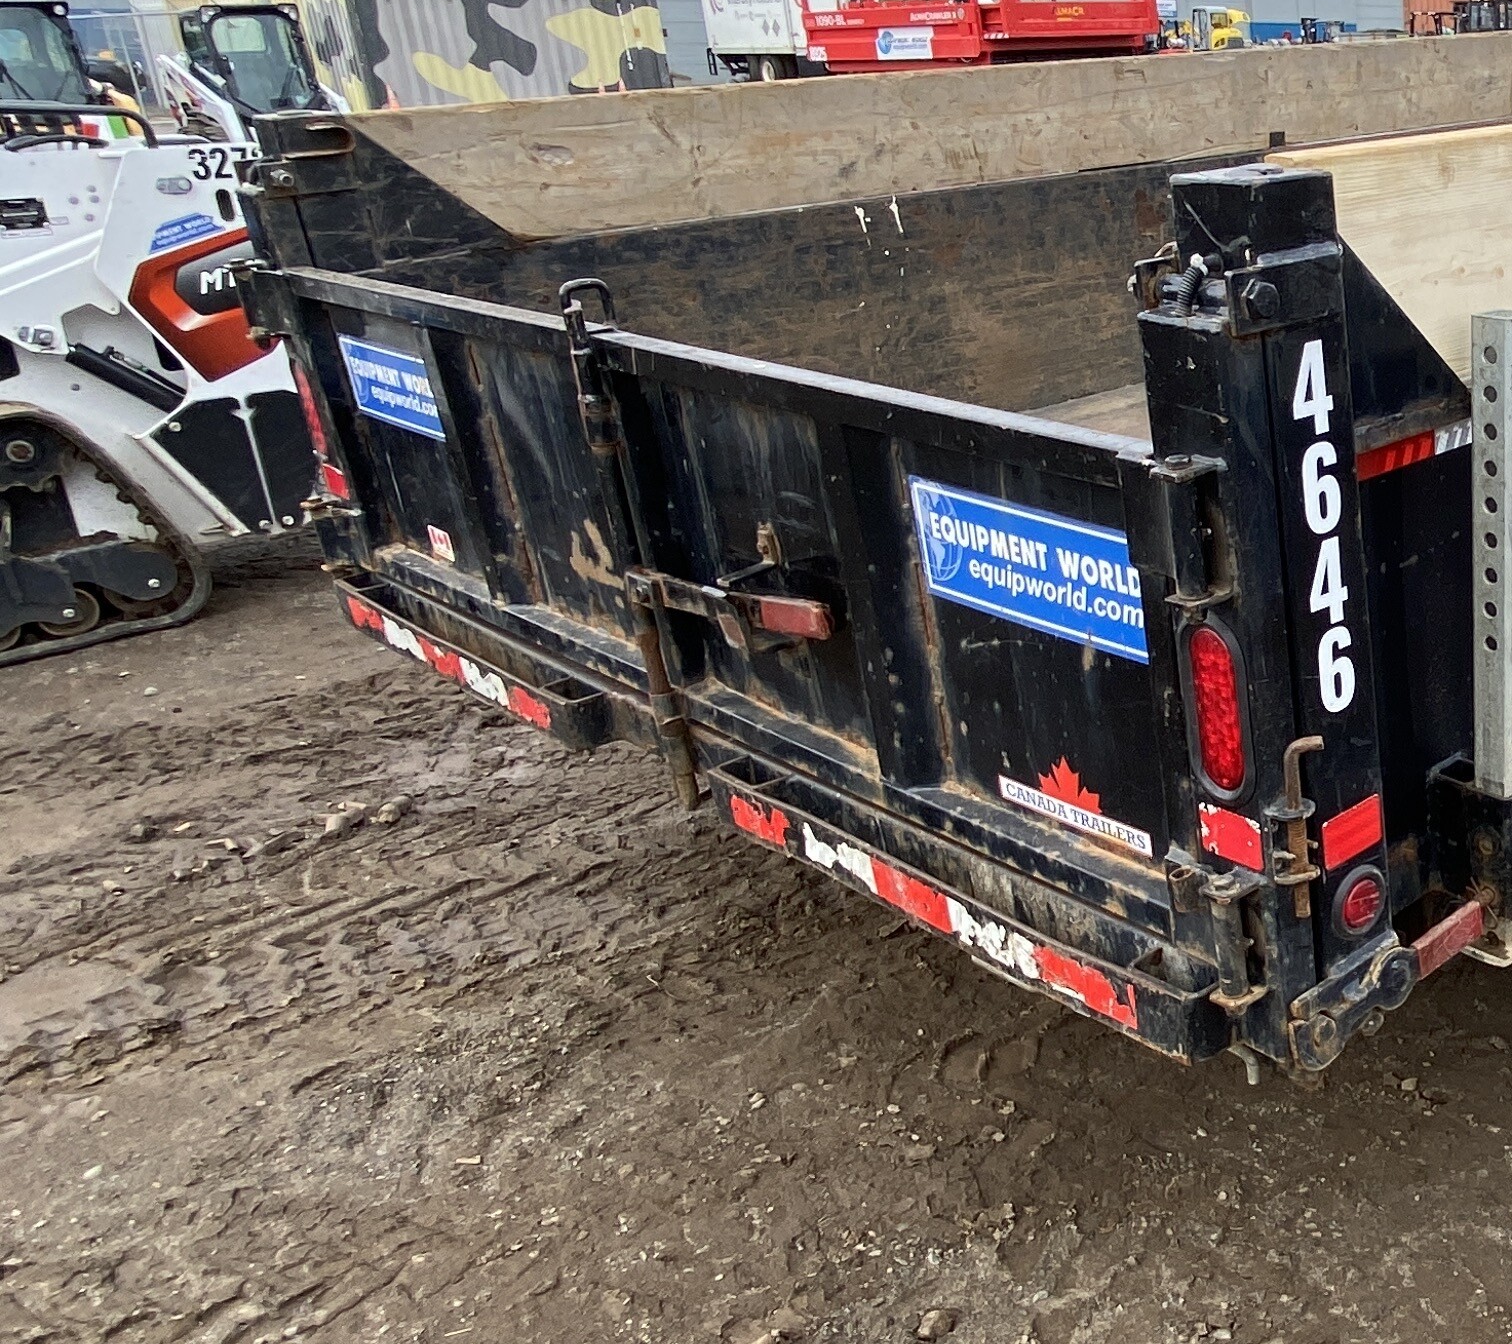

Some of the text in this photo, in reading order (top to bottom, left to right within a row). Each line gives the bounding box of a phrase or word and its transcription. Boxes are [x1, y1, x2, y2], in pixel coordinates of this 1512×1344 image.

[188, 147, 262, 180] 327
[349, 356, 401, 389] EQUIPMENT
[929, 511, 1142, 598] EQUIPMENT WORLD
[1293, 339, 1356, 713] 4646
[968, 558, 1145, 629] equipworld.com
[1005, 782, 1146, 850] CANADA TRAILERS
